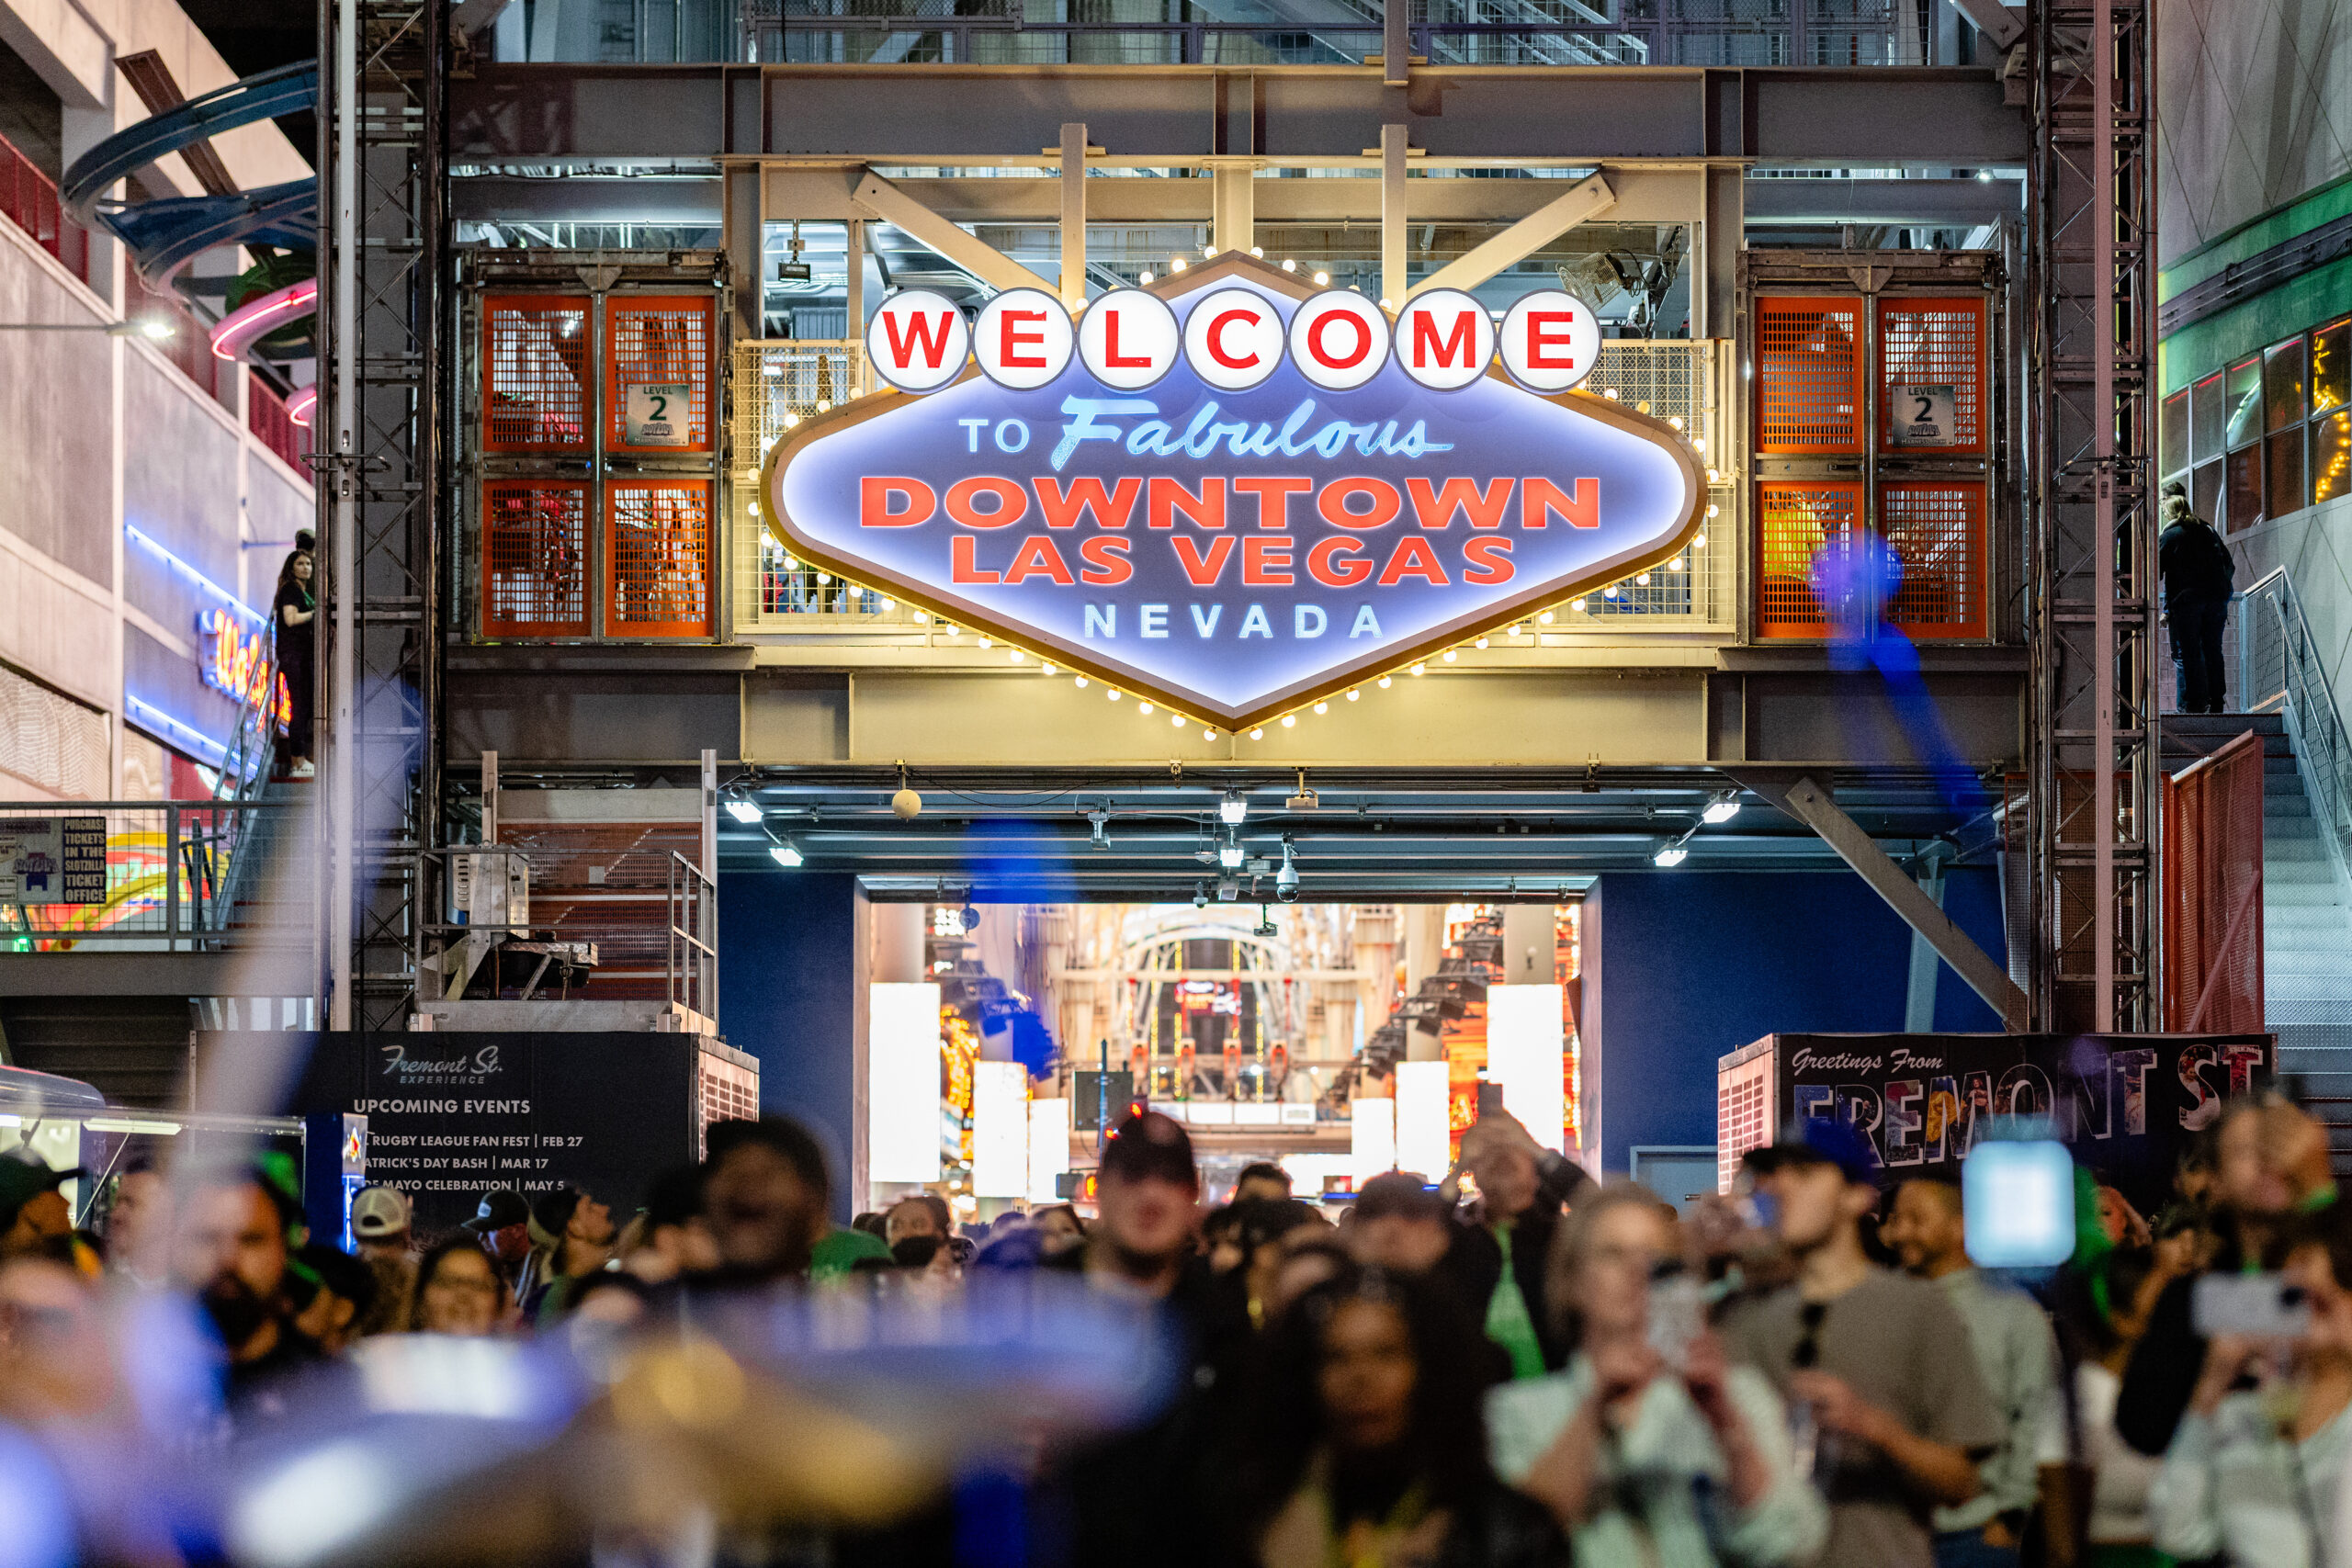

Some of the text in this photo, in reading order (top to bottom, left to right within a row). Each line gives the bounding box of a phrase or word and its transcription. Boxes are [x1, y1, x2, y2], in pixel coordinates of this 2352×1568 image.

[882, 309, 1574, 369] WELCOME
[643, 386, 673, 395] LEVEL
[1907, 387, 1939, 396] LEVEL
[649, 396, 667, 421] 2
[1915, 397, 1933, 422] 2
[958, 394, 1454, 471] TO Fabulous
[860, 476, 1600, 530] DOWNTOWN
[952, 536, 1516, 587] LAS VEGAS
[1084, 604, 1384, 639] NEVADA
[64, 818, 106, 830] PURCHASE
[64, 833, 106, 844] TICKETS
[65, 846, 106, 858] IN THE
[65, 860, 106, 872] SLOTZILLA
[65, 874, 106, 887] TICKET
[65, 888, 106, 902] OFFICE
[381, 1044, 503, 1075] Fremont St.
[1792, 1048, 1944, 1076] Greetings From
[400, 1076, 485, 1085] EXPERIENCE
[354, 1099, 531, 1114] UPCOMING EVENTS
[1793, 1043, 2264, 1168] FREMONT ST
[372, 1135, 417, 1146] RUGBY
[421, 1136, 469, 1146] LEAGUE
[473, 1136, 499, 1146] FAN
[503, 1136, 530, 1146] FEST
[542, 1136, 564, 1146] FEB
[567, 1136, 583, 1147] 27
[365, 1157, 420, 1168] ATRICK'S
[424, 1158, 449, 1168] DAY
[452, 1158, 488, 1168] BASH
[501, 1158, 531, 1168] MAR
[536, 1159, 548, 1168] 17
[382, 1179, 423, 1190] MAYO
[425, 1180, 511, 1190] CELEBRATION
[525, 1180, 553, 1190] MAY
[557, 1180, 564, 1190] 5
